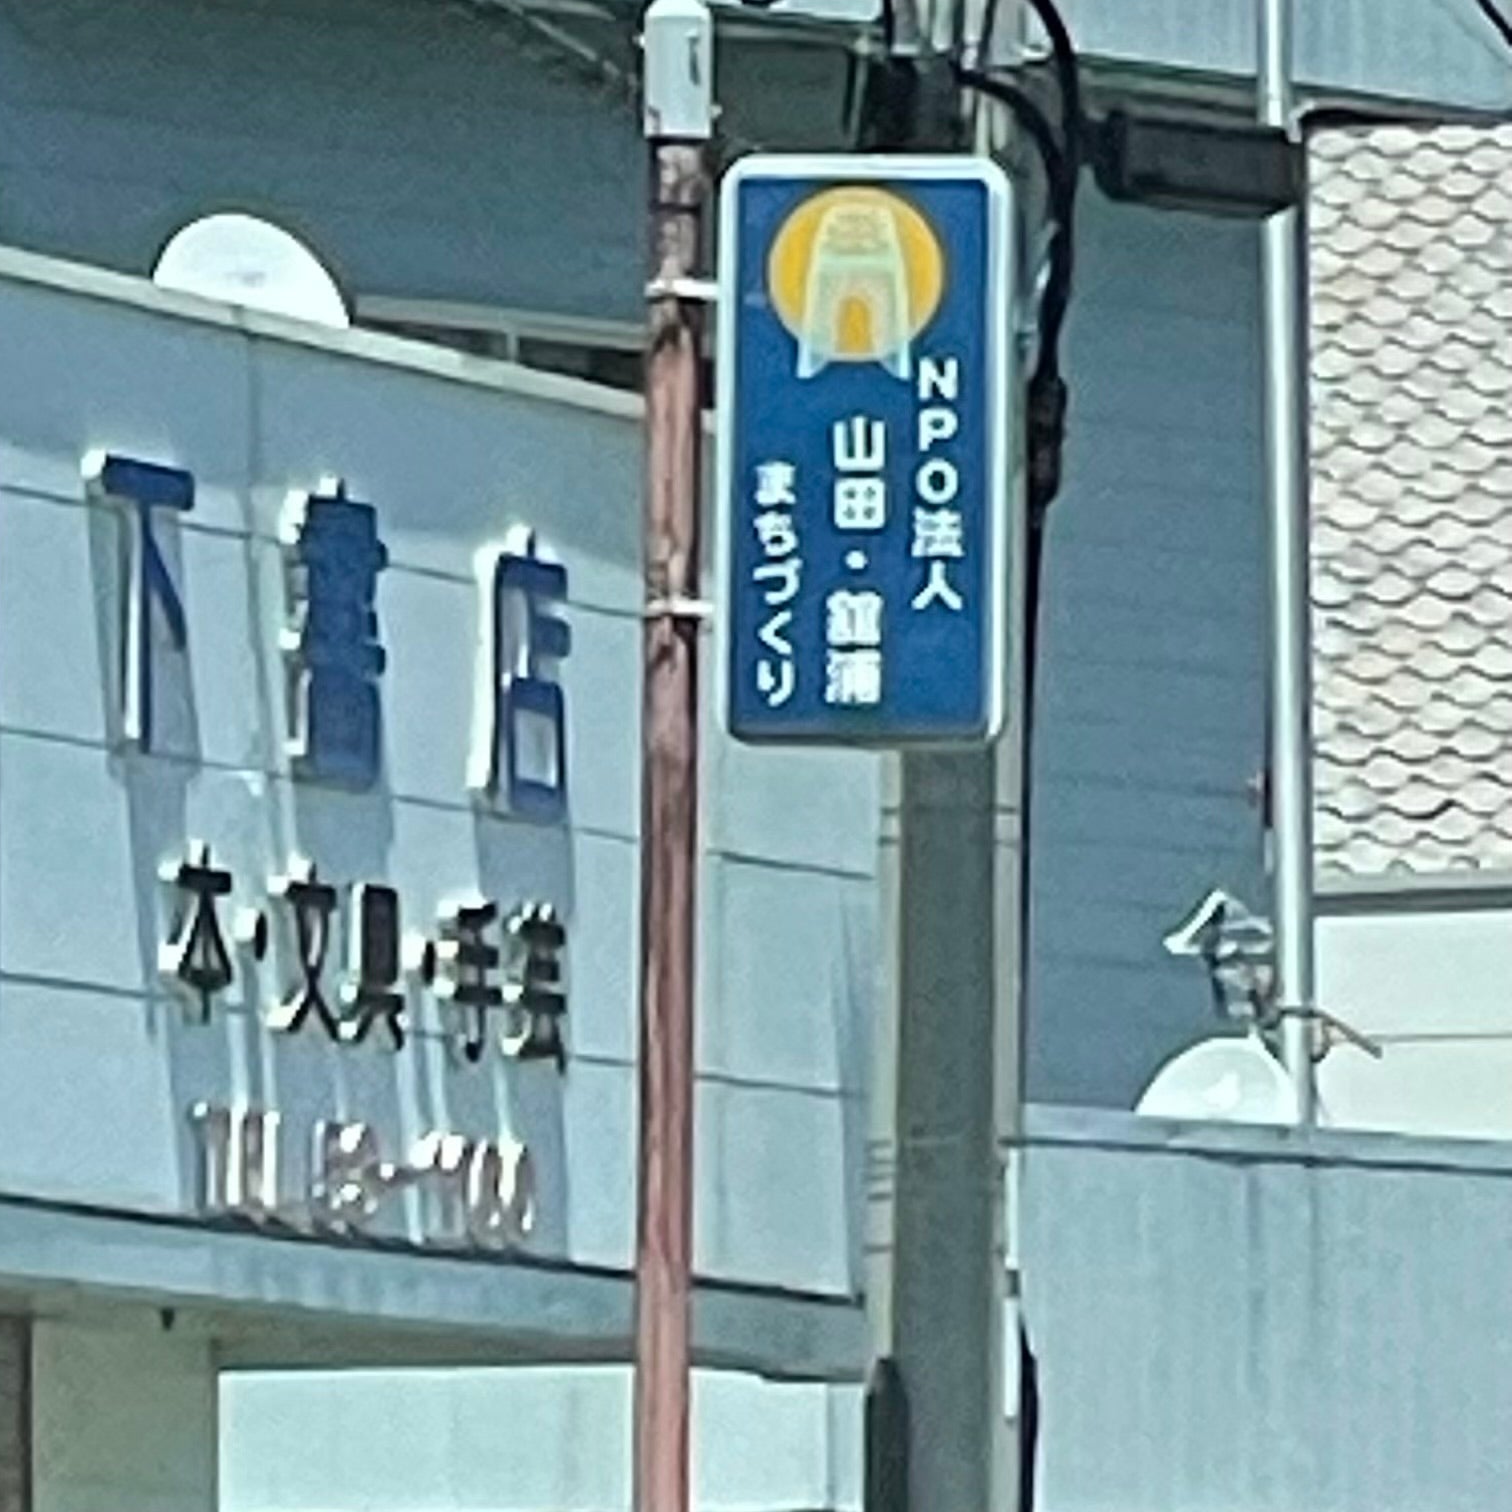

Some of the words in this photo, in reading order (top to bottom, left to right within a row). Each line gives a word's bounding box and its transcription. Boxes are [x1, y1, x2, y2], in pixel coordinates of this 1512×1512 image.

[753, 461, 800, 707] まちづくり
[911, 357, 965, 611] NPO法人
